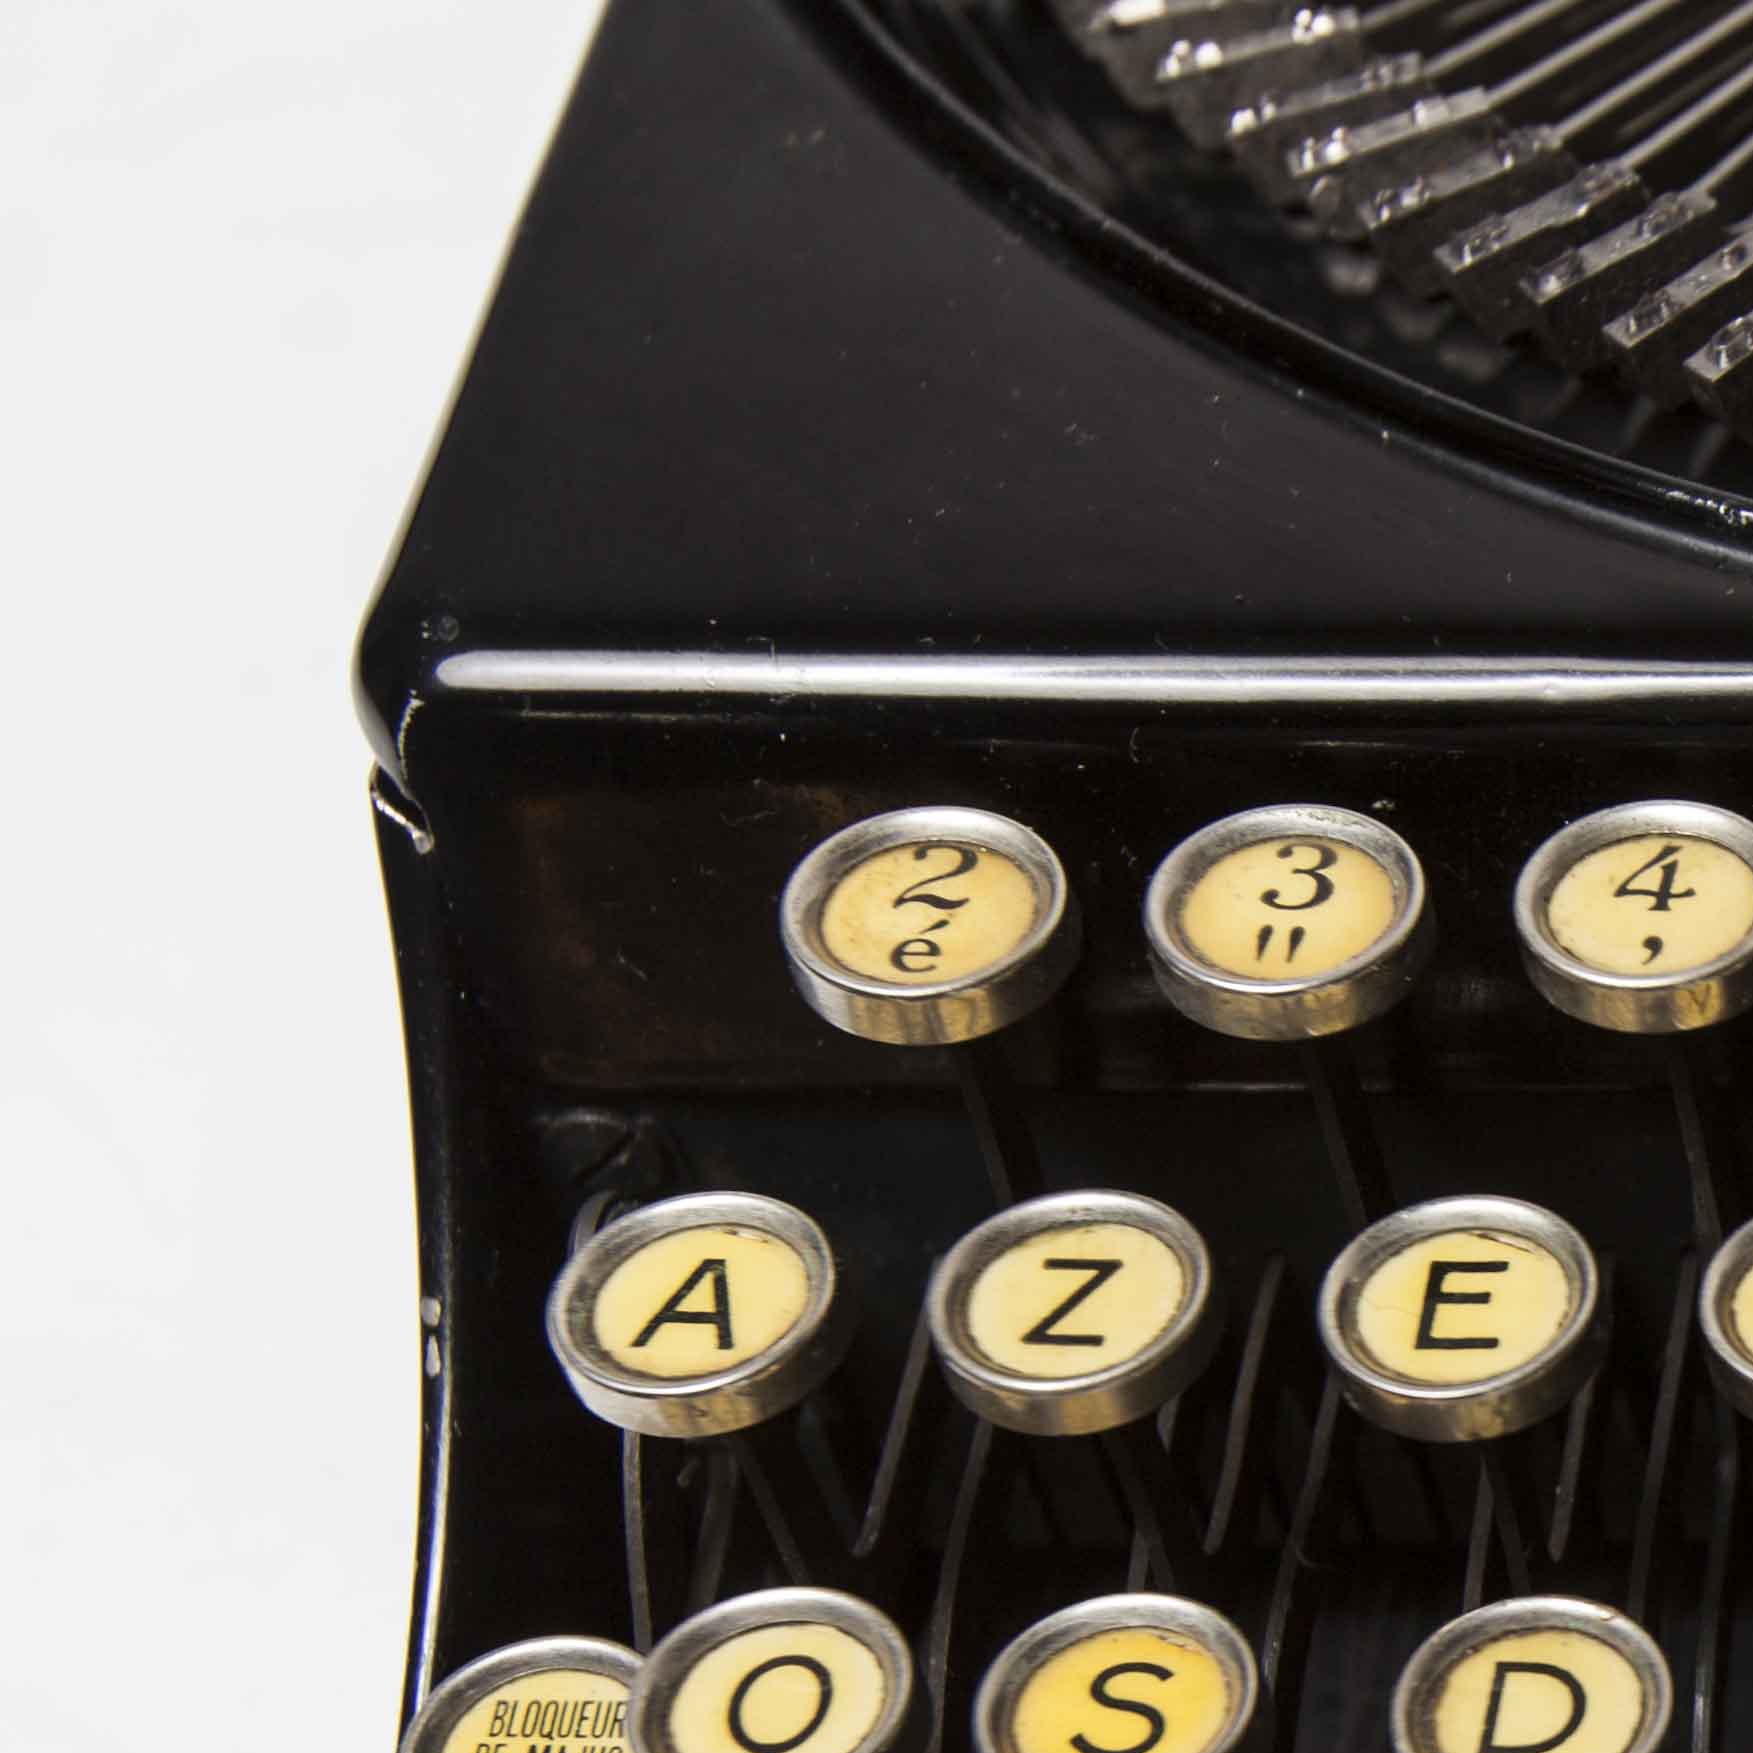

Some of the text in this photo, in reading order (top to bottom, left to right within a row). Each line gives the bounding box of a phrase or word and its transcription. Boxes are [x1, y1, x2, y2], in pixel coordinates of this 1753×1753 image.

[892, 850, 979, 911] 2
[1260, 845, 1338, 911] 3
[1613, 844, 1696, 912] 4
[889, 915, 950, 974] é
[630, 1257, 735, 1351] A
[1020, 1257, 1124, 1348] Z
[1413, 1259, 1511, 1351] E
[488, 1699, 629, 1741] BLOQUEUR
